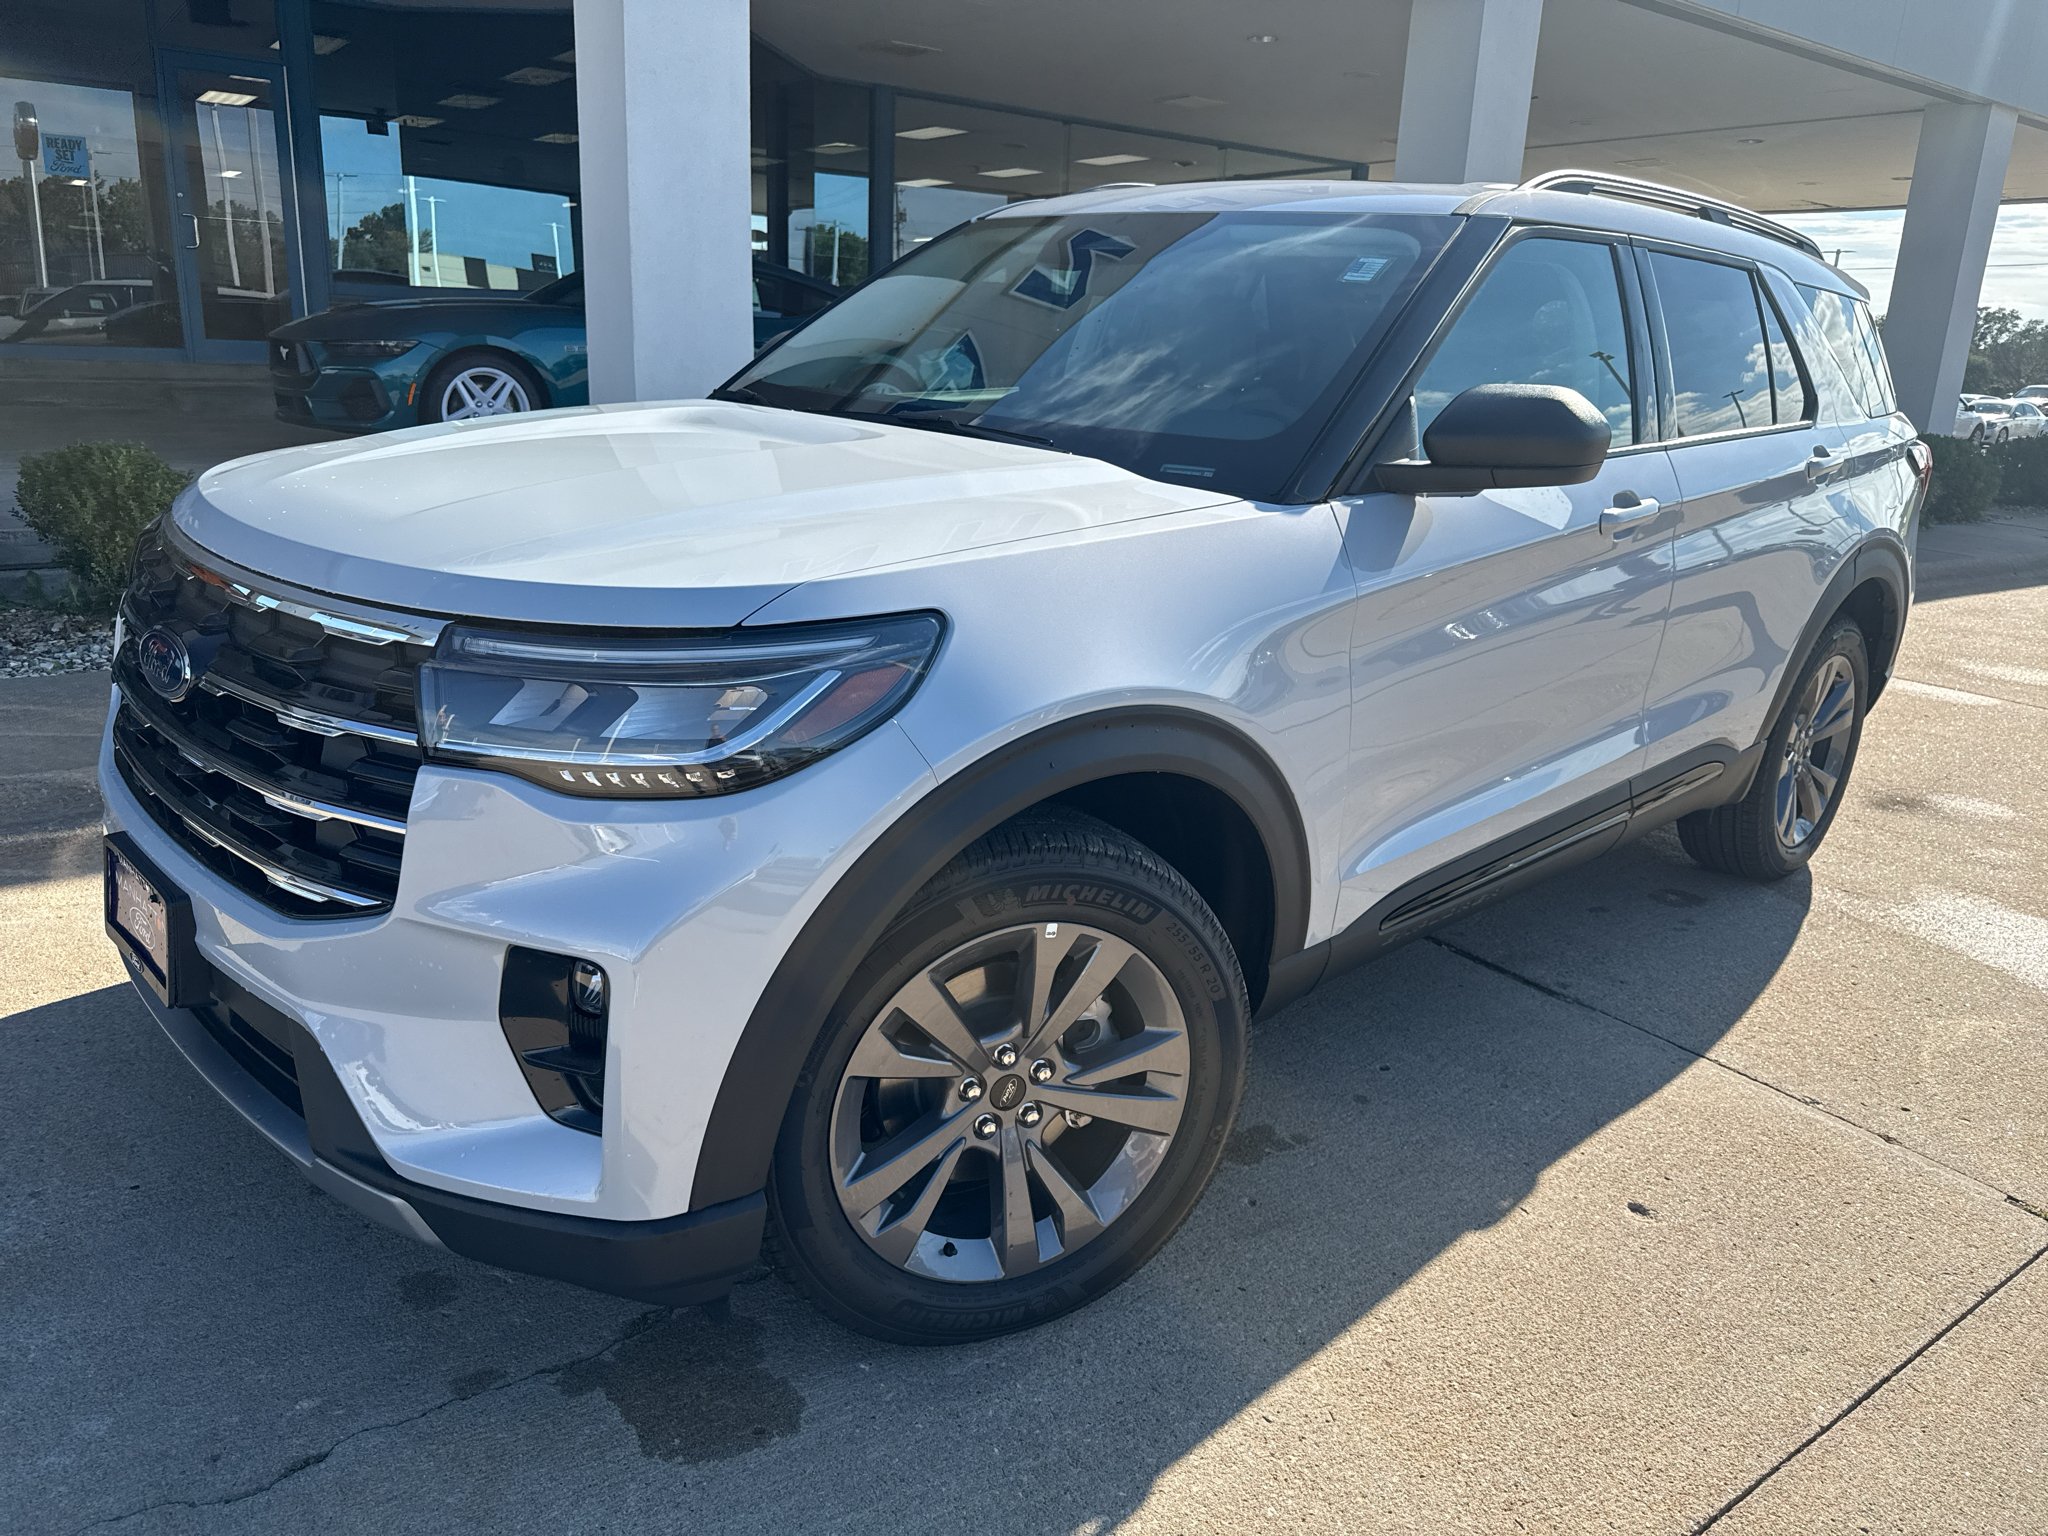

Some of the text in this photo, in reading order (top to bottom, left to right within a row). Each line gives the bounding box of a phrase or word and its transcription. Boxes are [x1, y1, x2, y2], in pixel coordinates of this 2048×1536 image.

[45, 136, 82, 151] READY
[55, 149, 75, 161] SET
[50, 160, 83, 174] Ford
[144, 639, 175, 684] Ford
[1025, 884, 1154, 920] MICHELIN
[134, 912, 151, 944] Ford
[1166, 922, 1205, 962] 255/55
[1206, 976, 1221, 995] 20
[1003, 1083, 1015, 1103] Ford
